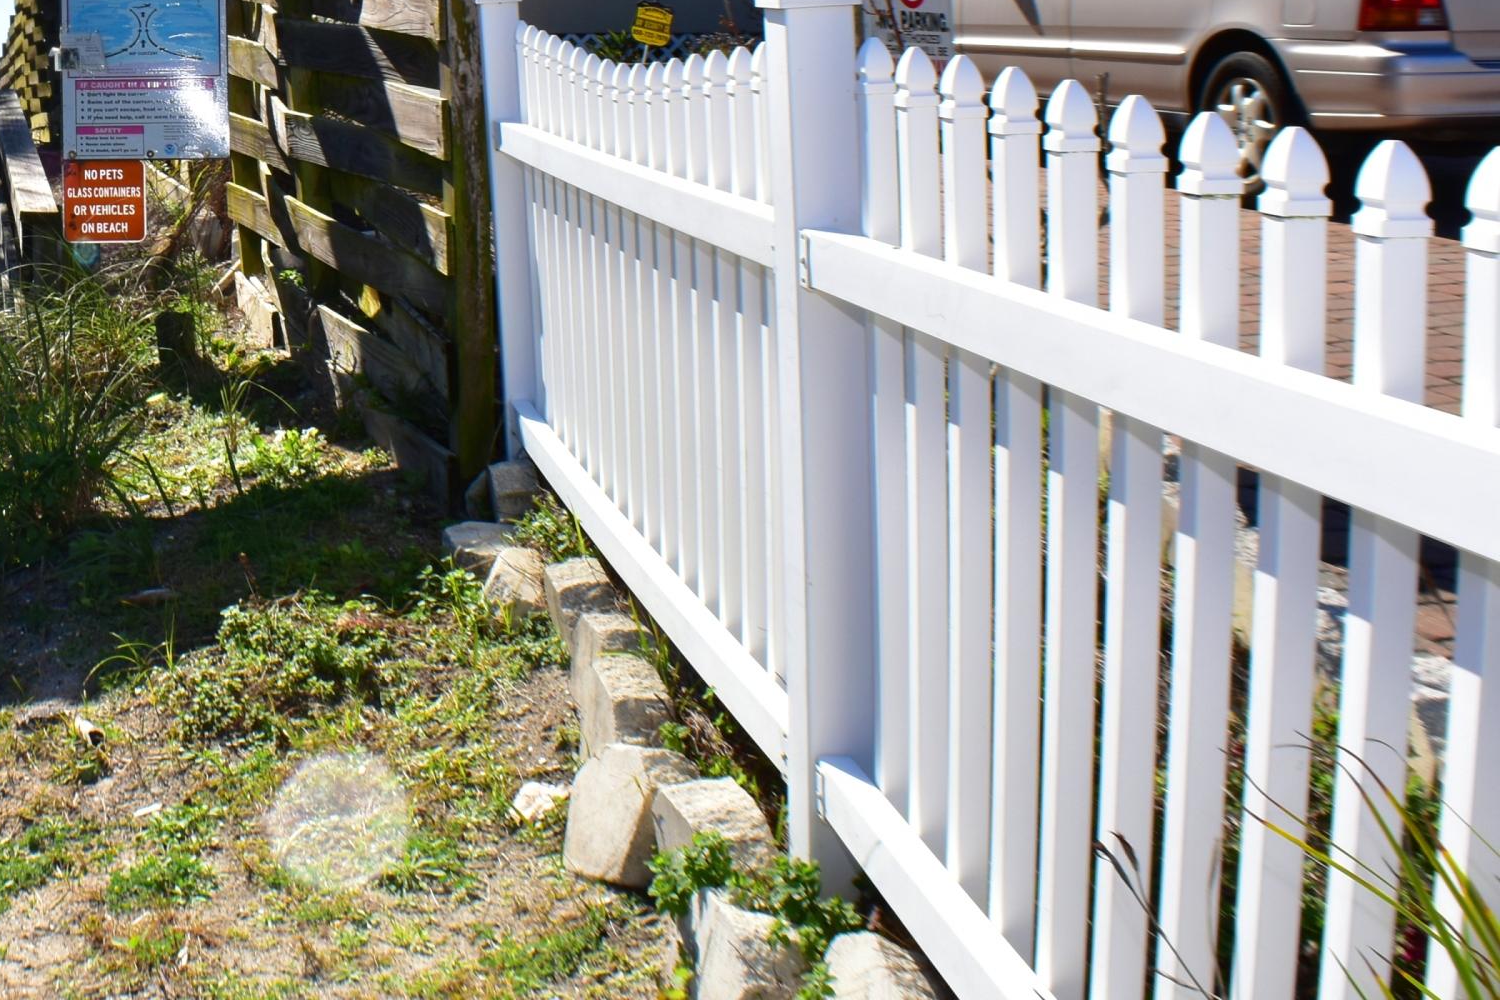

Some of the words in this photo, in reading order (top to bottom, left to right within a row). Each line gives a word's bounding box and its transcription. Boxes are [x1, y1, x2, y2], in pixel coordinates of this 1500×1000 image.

[84, 169, 97, 180] NO
[100, 169, 124, 180] PETS
[67, 187, 92, 198] GLASS
[94, 186, 141, 198] CONTAINERS
[74, 205, 87, 216] OR
[89, 204, 136, 216] VEHICLES
[81, 222, 95, 233] ON
[97, 222, 128, 233] BEACH
